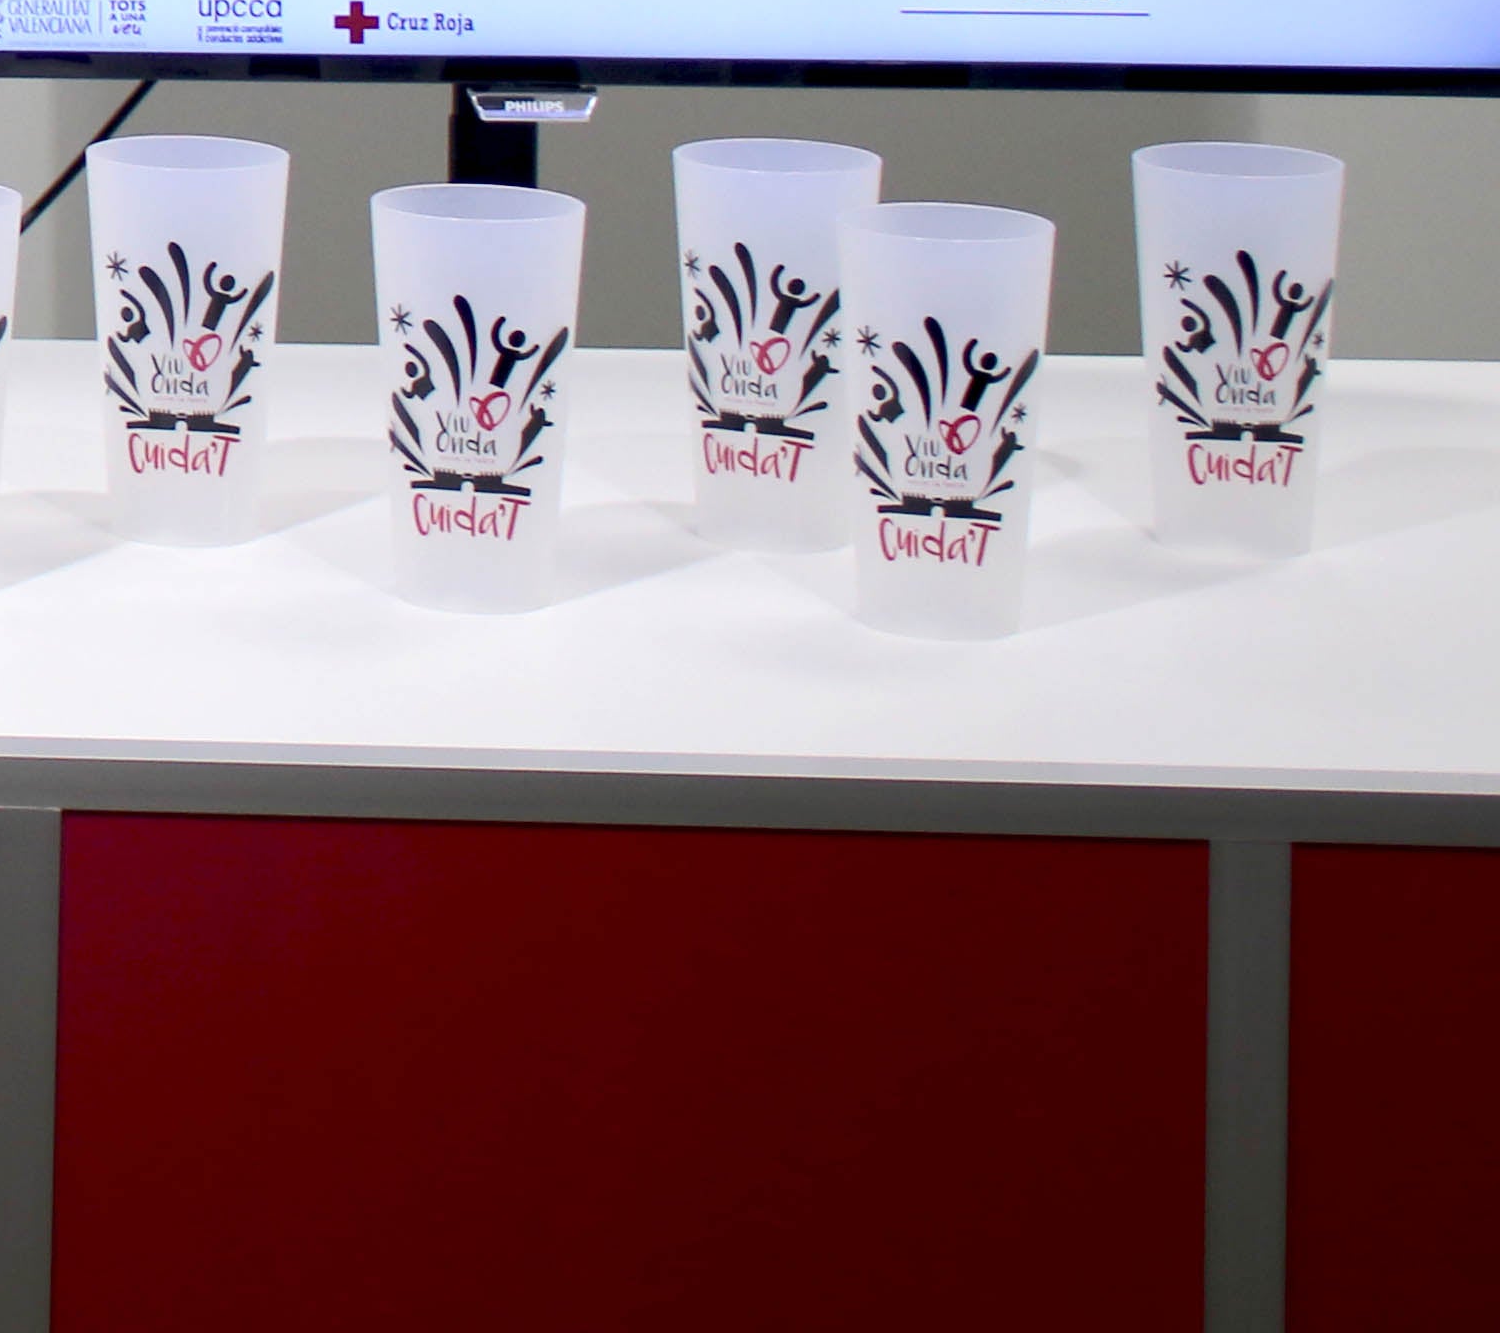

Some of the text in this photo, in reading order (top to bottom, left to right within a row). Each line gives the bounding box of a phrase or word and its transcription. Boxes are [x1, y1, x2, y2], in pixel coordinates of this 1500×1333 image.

[109, 0, 146, 11] TOTS
[387, 13, 474, 35] Cruz Roja
[505, 101, 564, 112] PHILIPS
[150, 369, 209, 397] Onda
[720, 372, 778, 400] Onda
[1214, 379, 1277, 407] Onda
[434, 428, 498, 456] Onda
[903, 453, 969, 482] Onda
